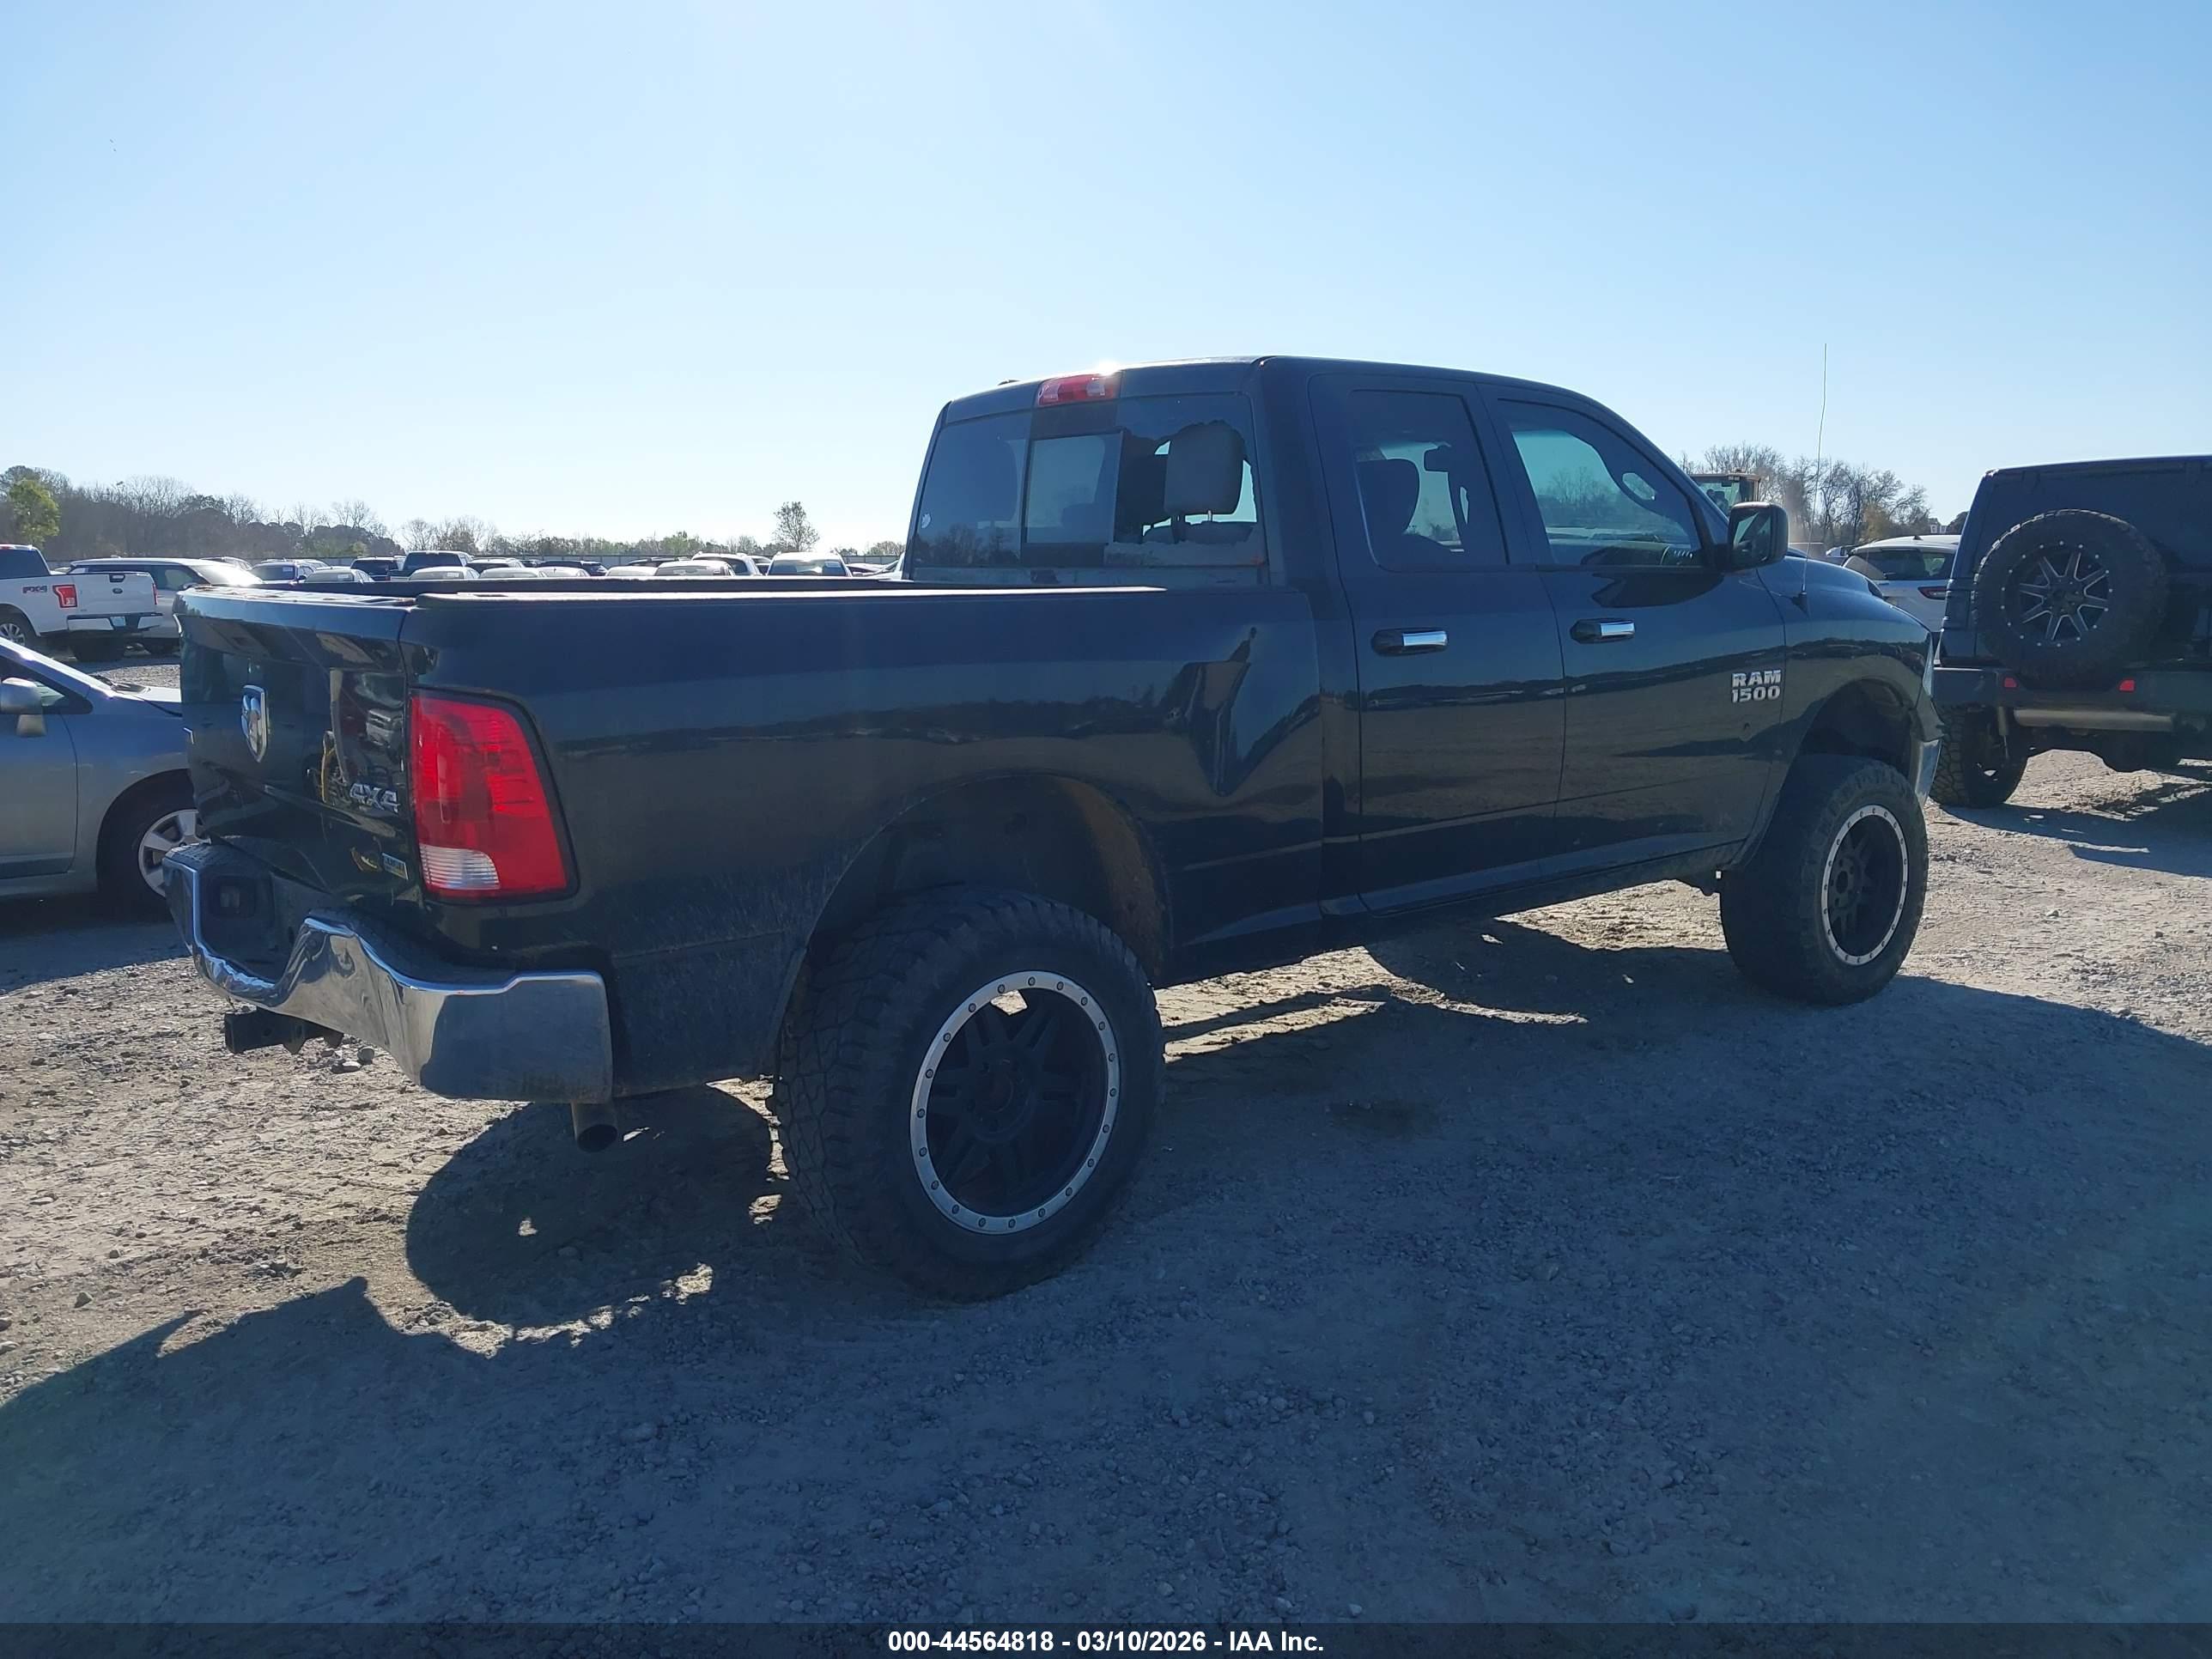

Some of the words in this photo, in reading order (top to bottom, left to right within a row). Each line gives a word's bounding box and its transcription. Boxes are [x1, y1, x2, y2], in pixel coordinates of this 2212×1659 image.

[22, 586, 48, 594] FX4
[1731, 670, 1782, 688] RAM
[1731, 684, 1781, 703] 1500
[349, 782, 401, 814] 4X4
